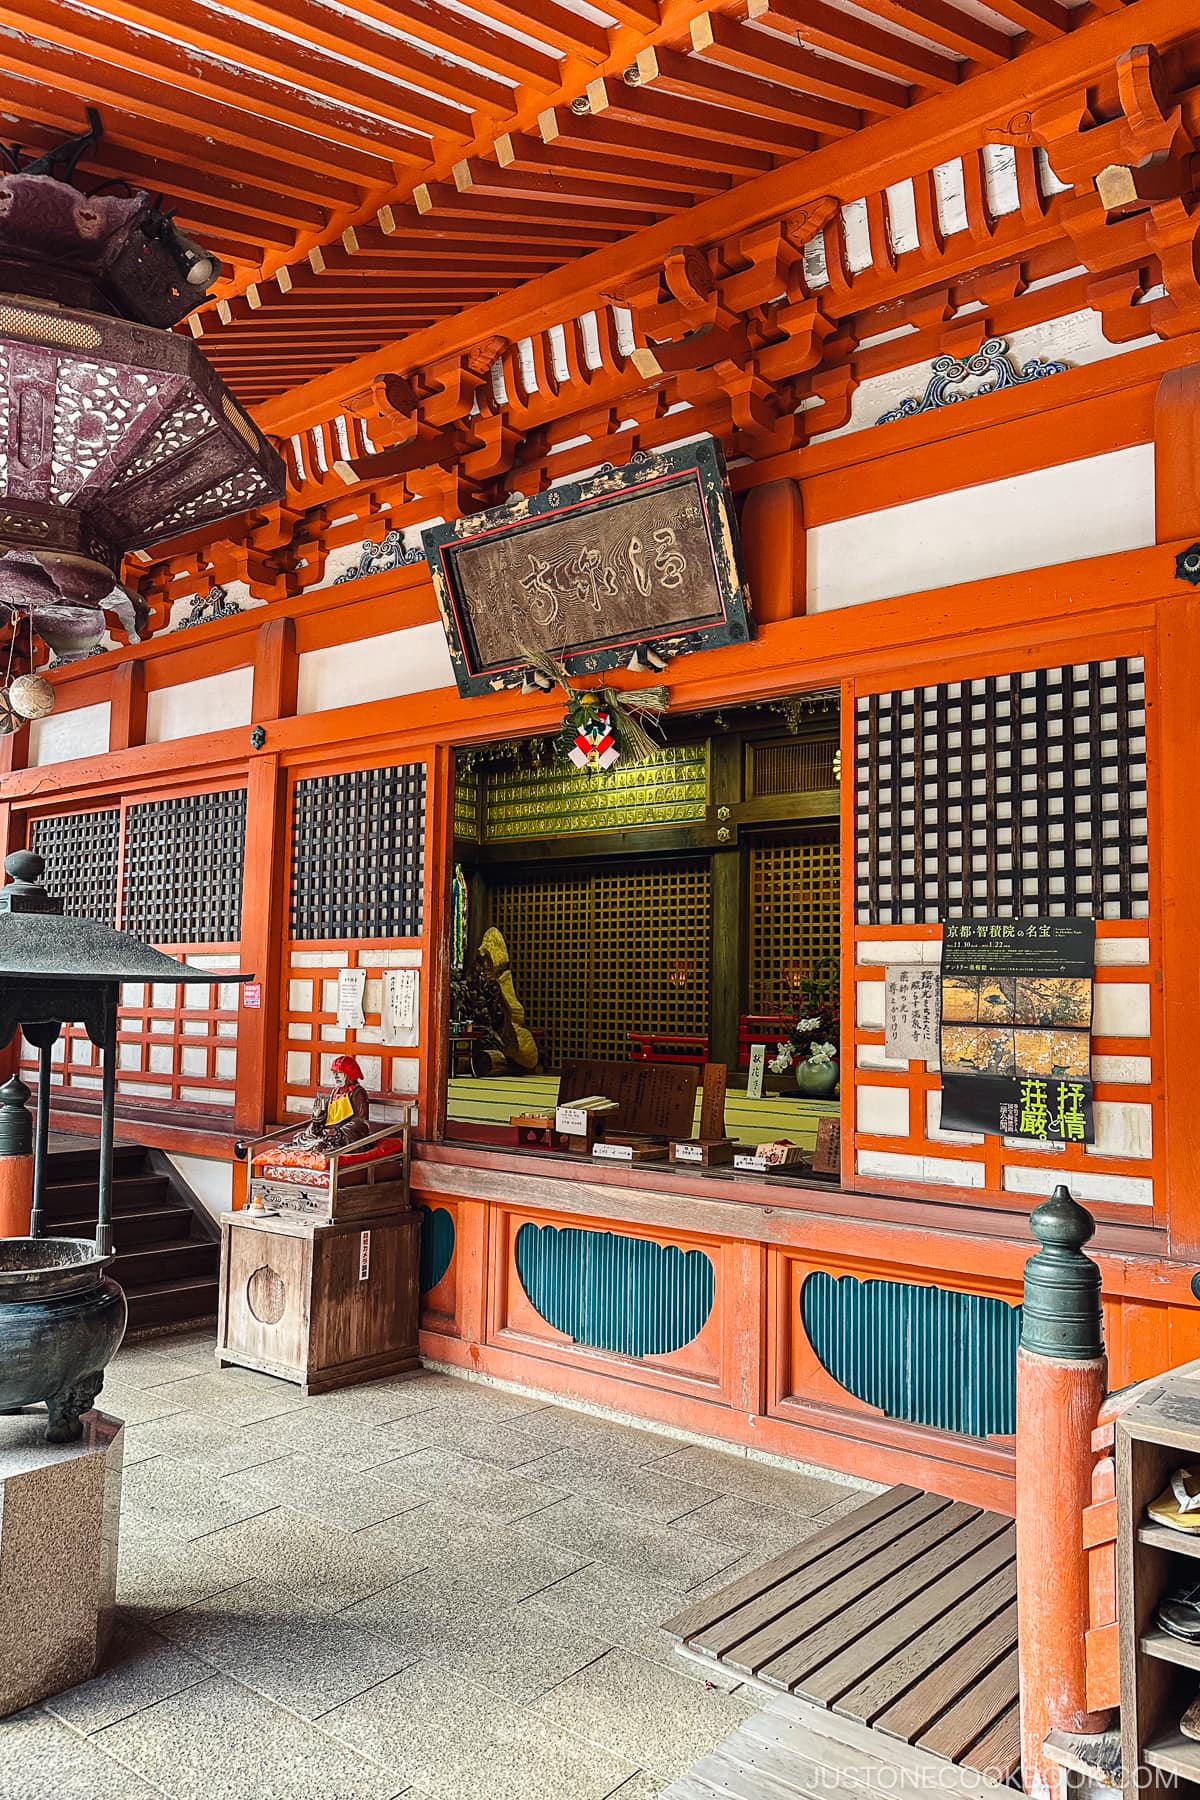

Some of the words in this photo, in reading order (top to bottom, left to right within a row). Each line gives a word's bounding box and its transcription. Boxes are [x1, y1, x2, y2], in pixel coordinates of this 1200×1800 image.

[946, 924, 1052, 939] 京都・智積院の名宝
